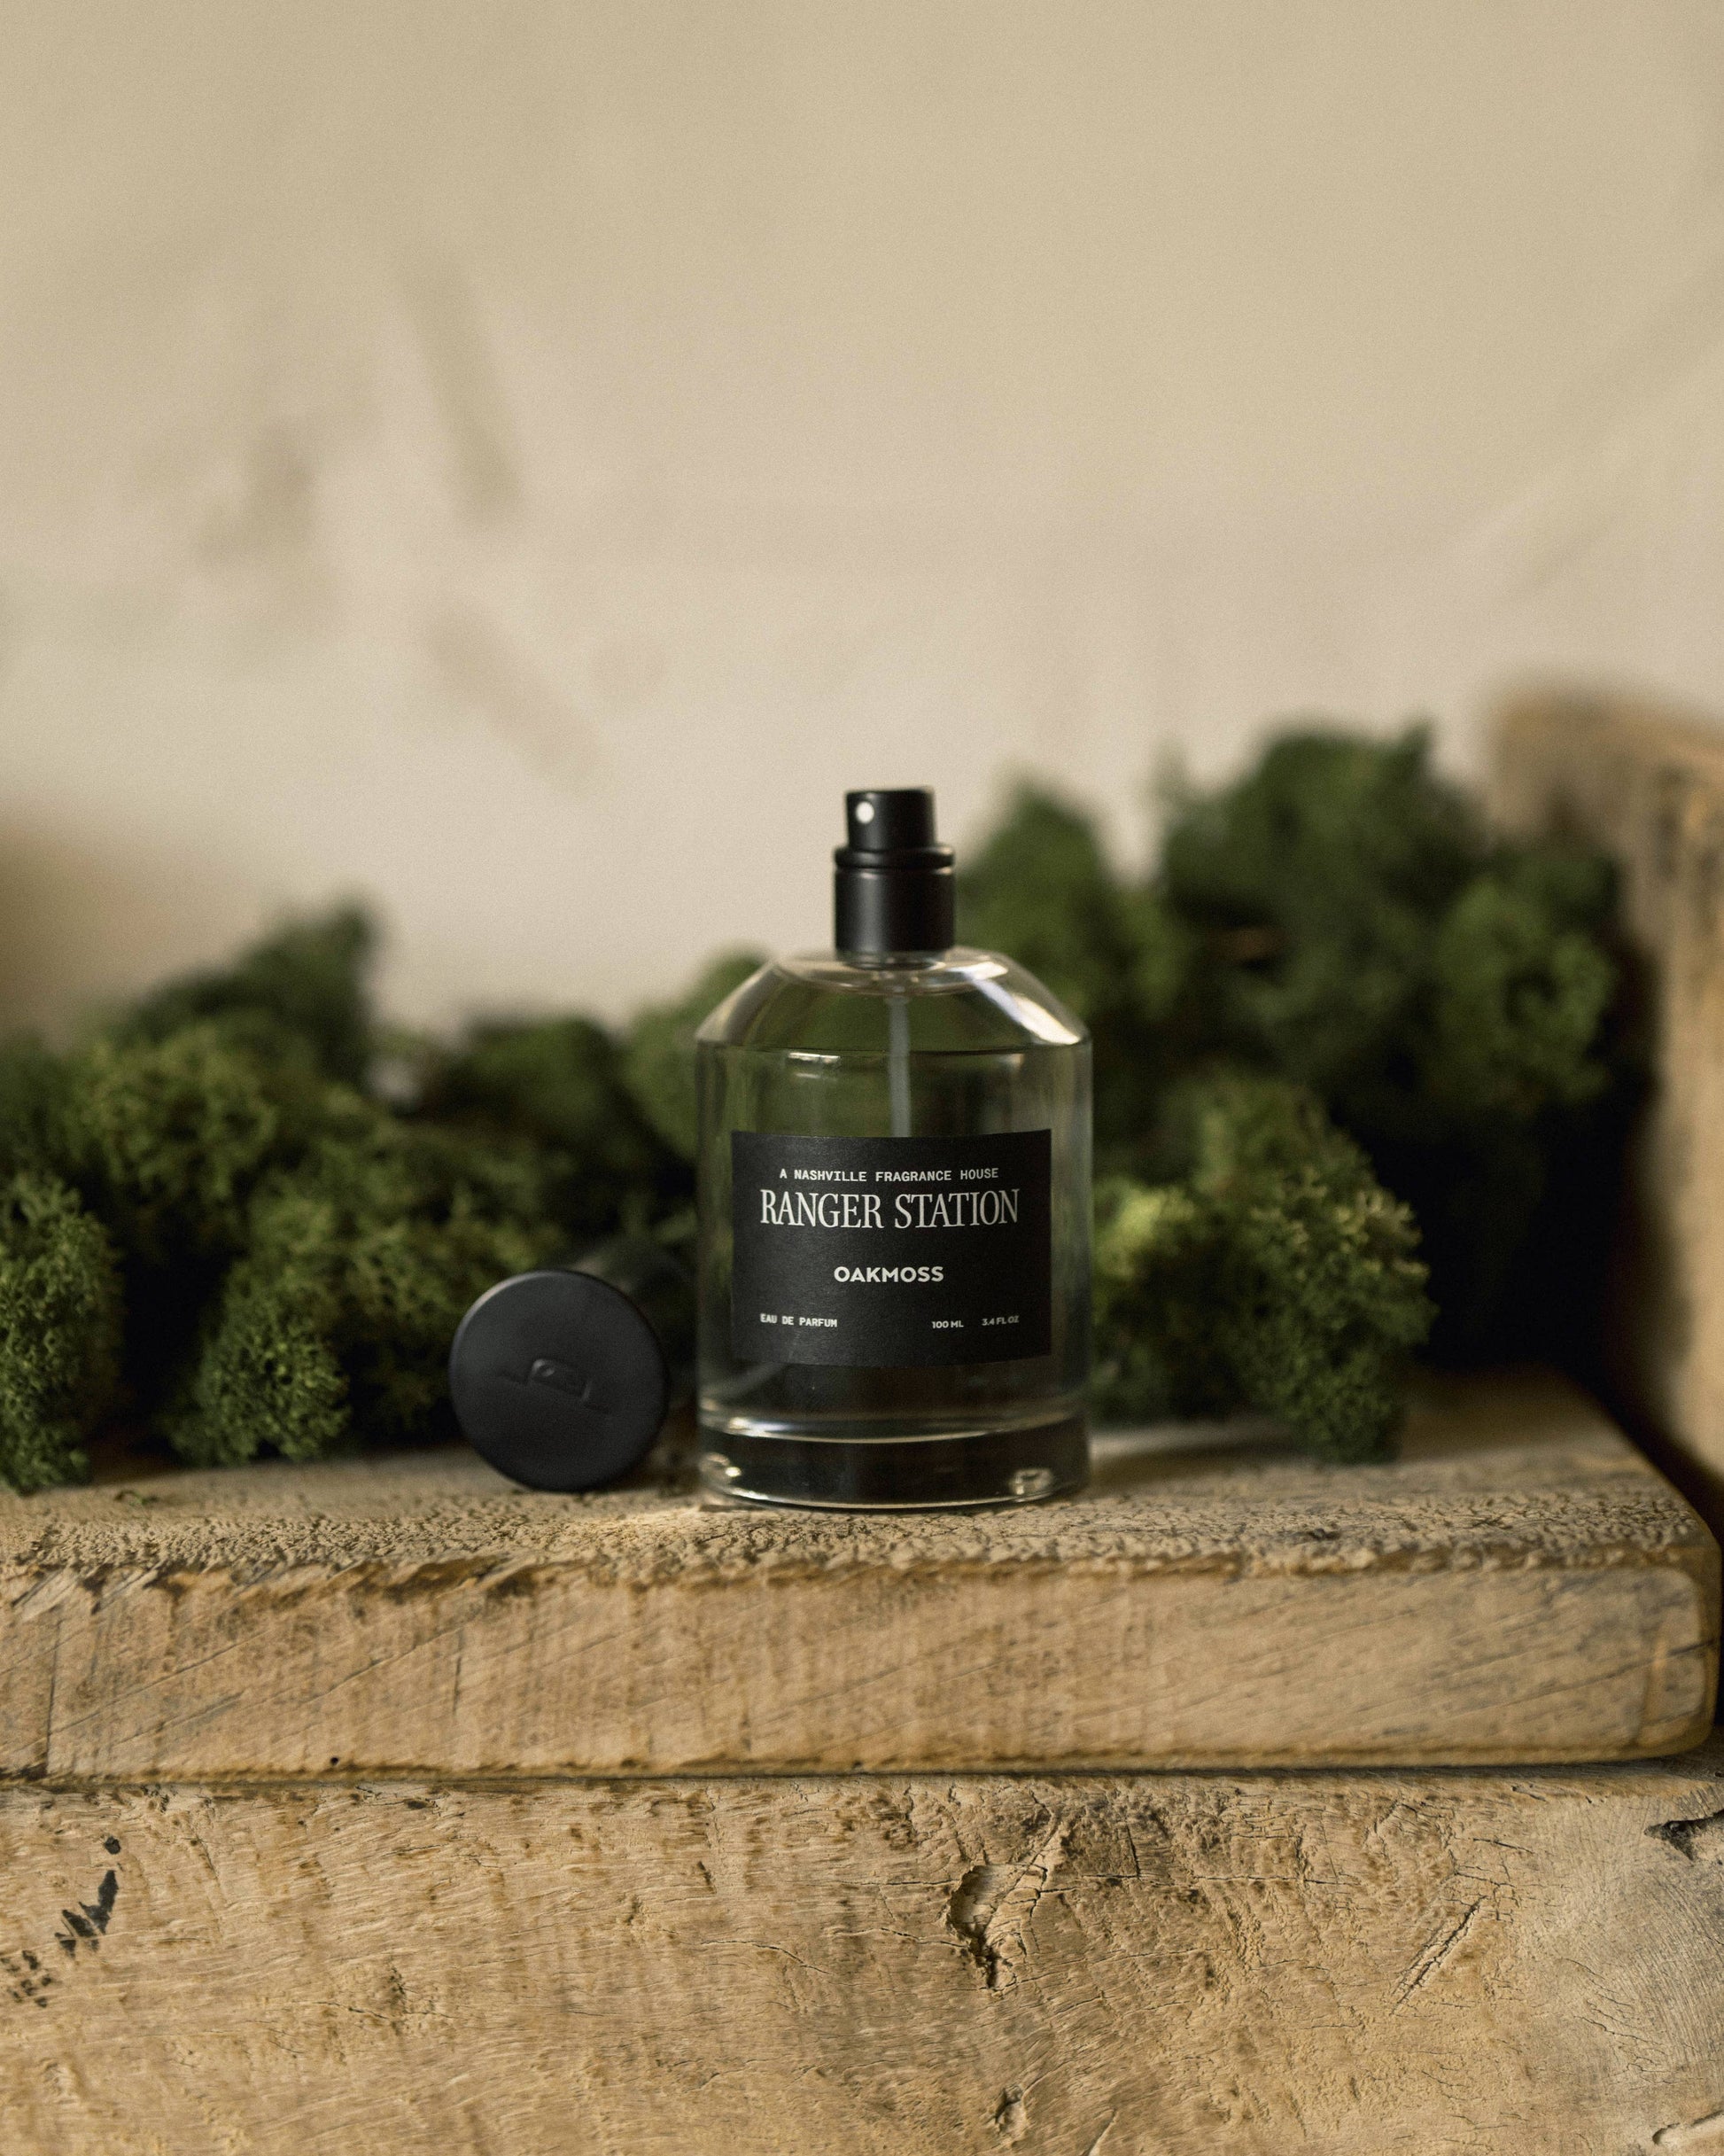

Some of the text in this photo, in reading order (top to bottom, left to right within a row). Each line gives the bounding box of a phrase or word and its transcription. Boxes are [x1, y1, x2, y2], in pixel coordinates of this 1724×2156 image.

[779, 1167, 999, 1182] A NASHVILLE FRAGRANCE HOUSE
[760, 1188, 1020, 1229] RANGER STATION
[834, 1265, 944, 1283] OAKMOSS
[759, 1313, 838, 1327] EAU DE PARFUM
[951, 1319, 964, 1328] ML
[982, 1318, 995, 1327] 3.4
[1007, 1315, 1020, 1324] OZ
